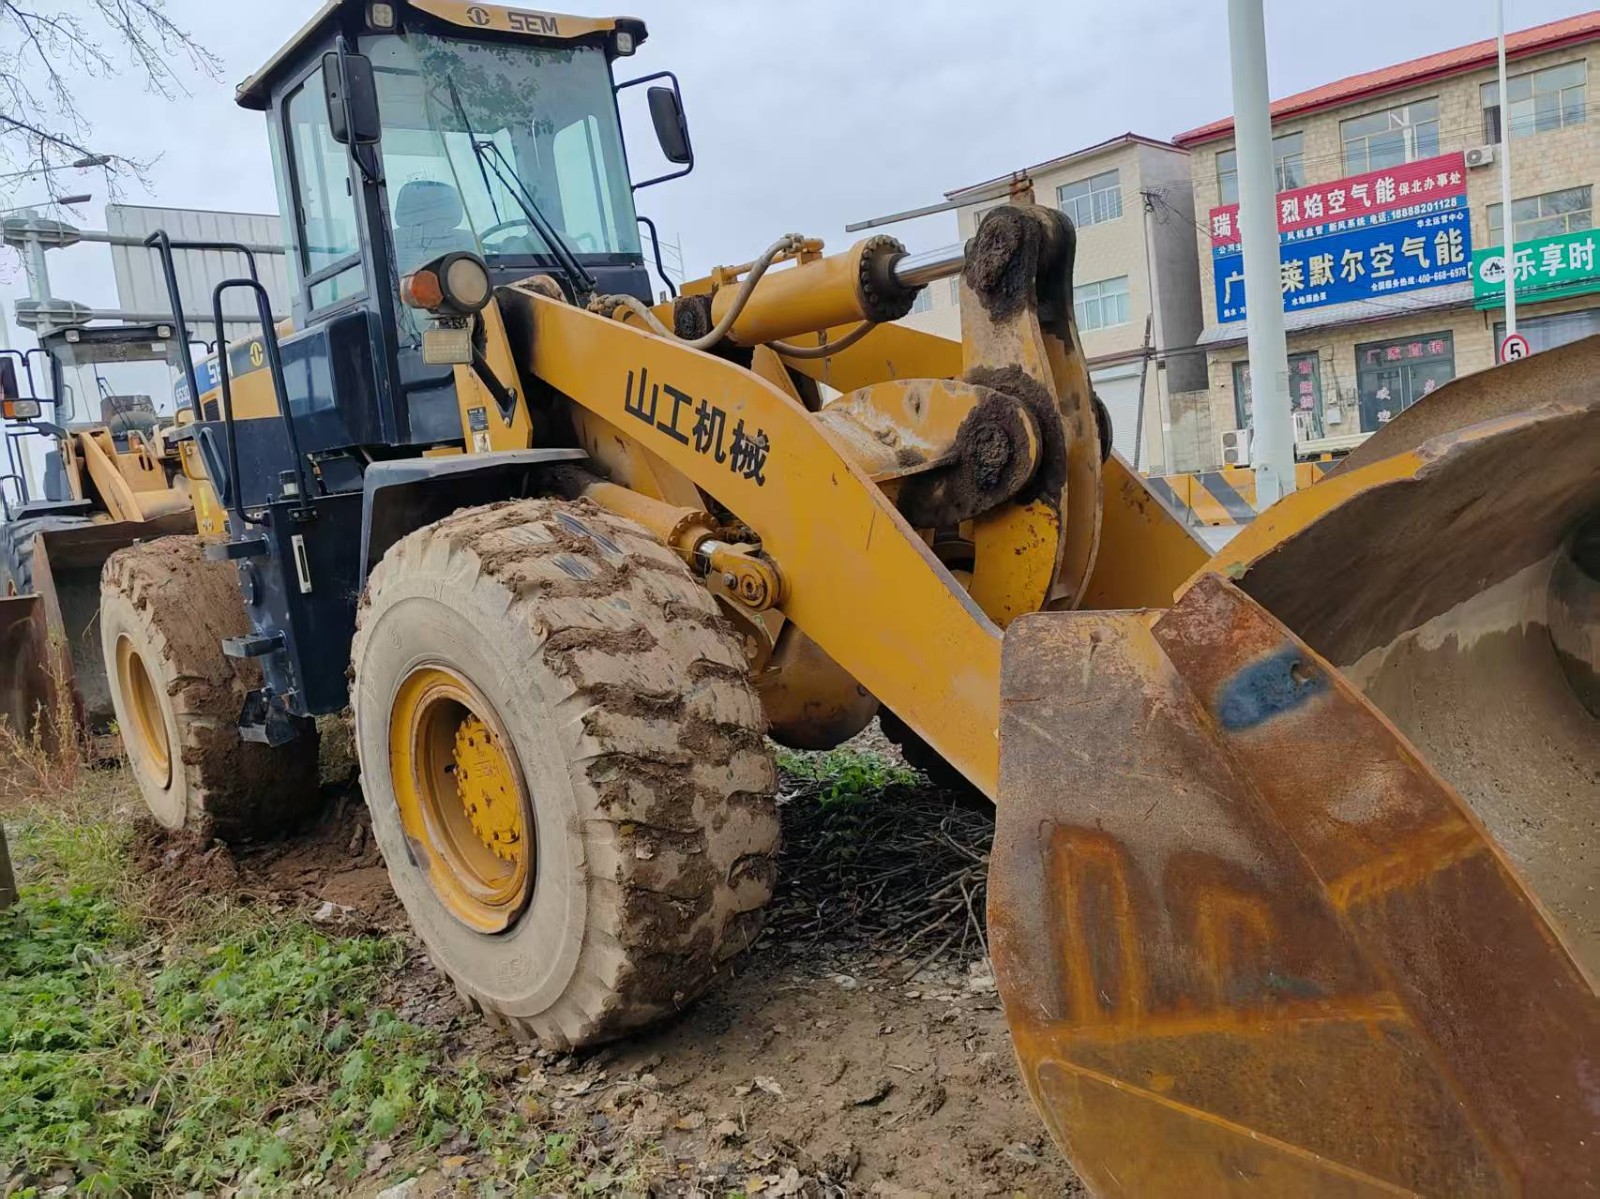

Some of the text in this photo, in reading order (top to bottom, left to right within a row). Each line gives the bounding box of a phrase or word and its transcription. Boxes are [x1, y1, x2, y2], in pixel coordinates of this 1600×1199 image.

[507, 11, 560, 36] SEM
[1513, 238, 1596, 281] 乐享时
[1510, 342, 1521, 360] 5
[624, 367, 770, 487] 山工机械
